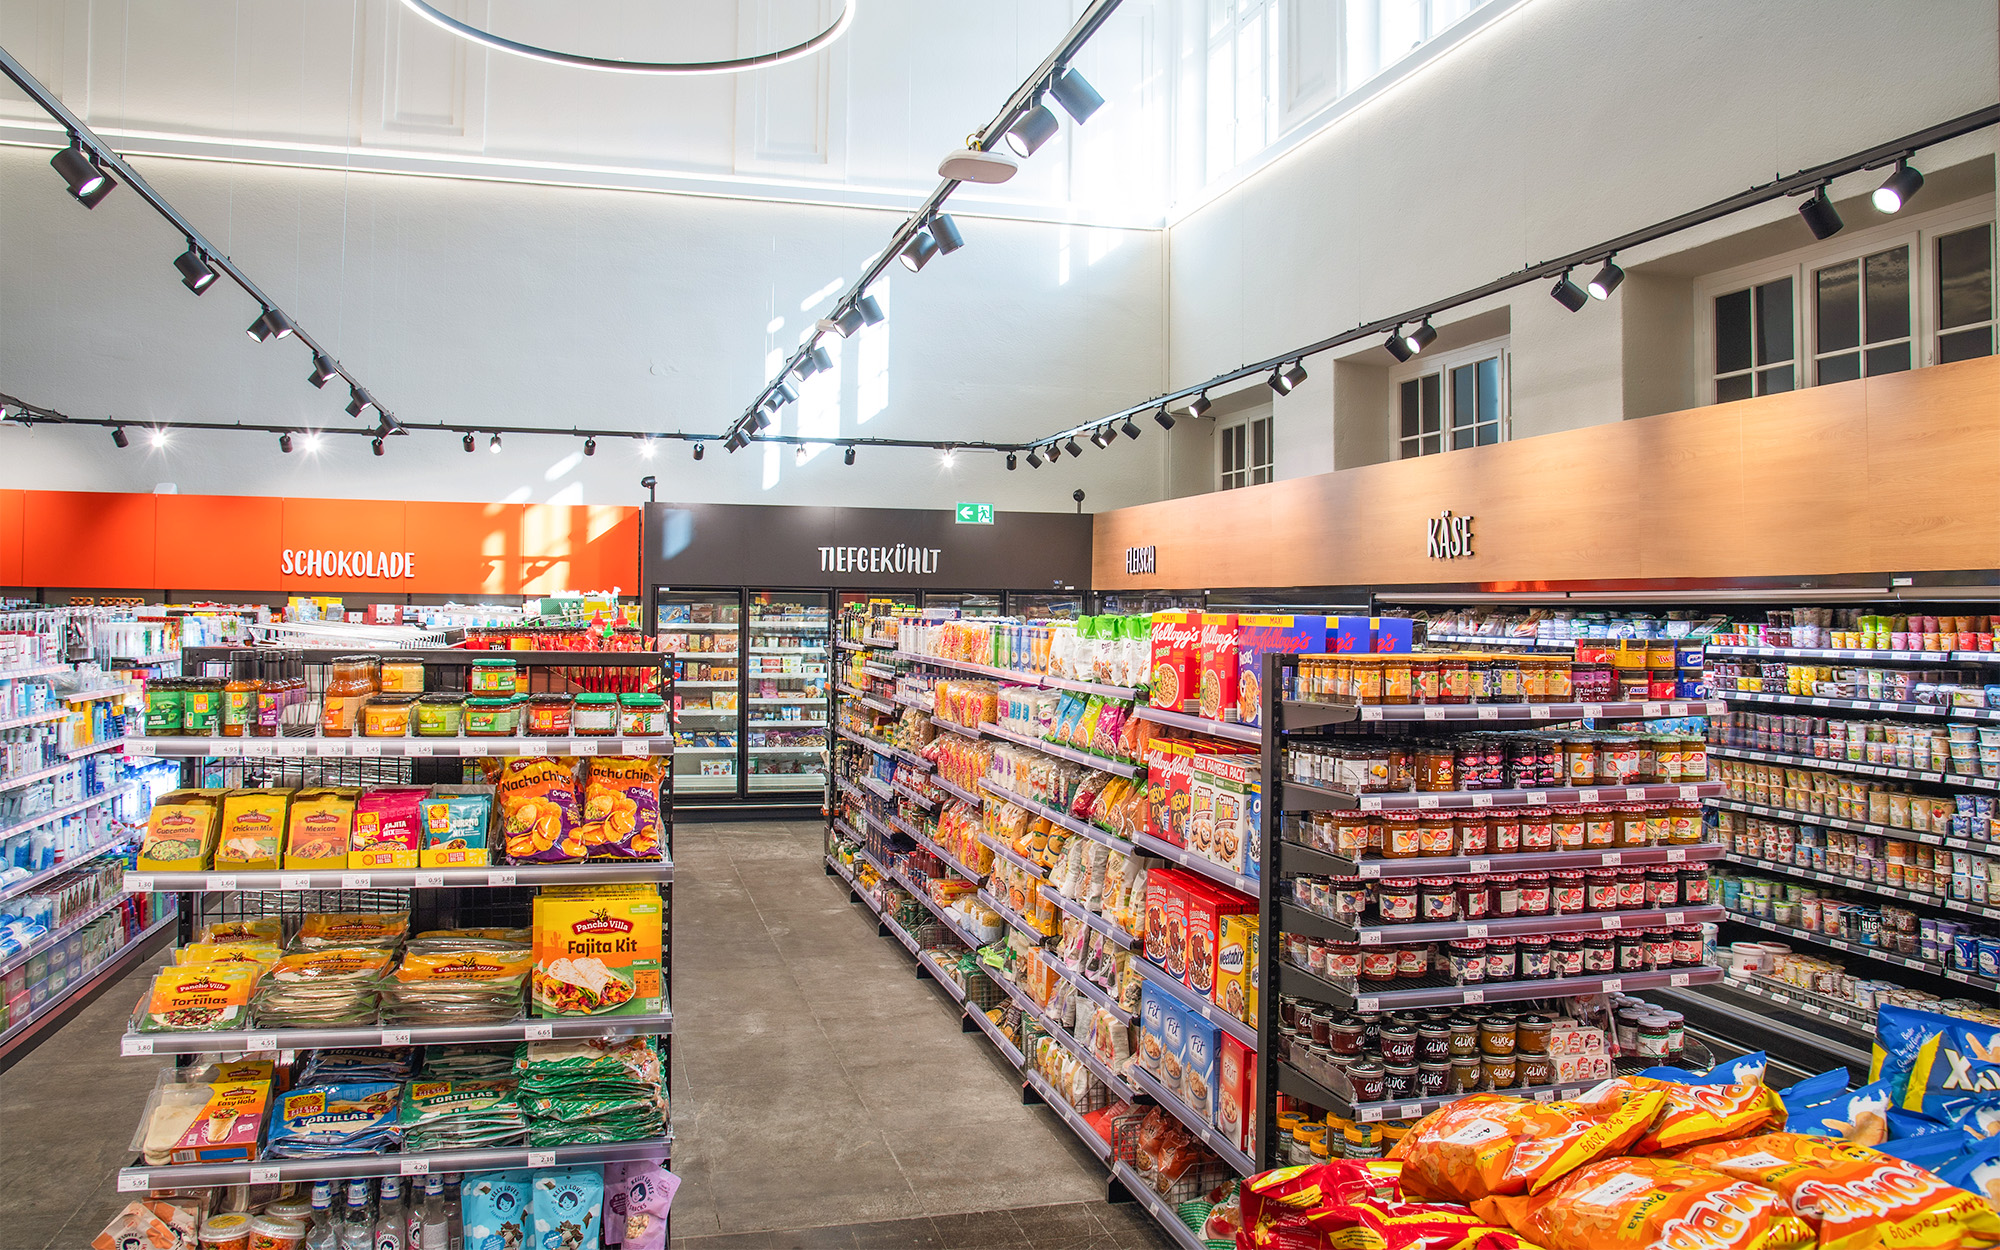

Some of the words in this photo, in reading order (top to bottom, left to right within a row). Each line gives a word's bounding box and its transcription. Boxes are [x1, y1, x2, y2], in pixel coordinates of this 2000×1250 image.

[1427, 511, 1474, 557] KÄSE
[281, 548, 416, 580] SCHOKOLADE
[818, 543, 941, 575] TIEFGEKÜHLT
[1126, 545, 1156, 575] FLEISCH
[1152, 622, 1200, 649] Kellogg's
[624, 769, 655, 782] Chips
[1229, 766, 1245, 782] PACK
[501, 775, 541, 793] Nacho
[541, 770, 572, 786] Chips
[156, 827, 196, 835] Guacamole
[232, 824, 260, 832] Chicken
[383, 820, 407, 831] FAJITA
[383, 829, 396, 837] MIX
[452, 829, 465, 838] MIX
[575, 920, 609, 933] Pancho
[609, 920, 629, 932] Villa
[567, 939, 613, 957] Fajita
[615, 937, 639, 953] Kit
[1219, 950, 1245, 966] Weetabix
[180, 982, 209, 993] Pancho
[209, 982, 226, 990] Villa
[171, 997, 228, 1007] Tortillas
[1146, 1000, 1161, 1019] Fit
[537, 1029, 551, 1037] 6.65
[1166, 1017, 1181, 1038] Fit
[261, 1040, 275, 1048] 4.55
[396, 1035, 409, 1043] 5.45
[1190, 1033, 1206, 1056] Fit
[1455, 1034, 1475, 1047] GLÜCK
[137, 1044, 152, 1052] 3.80
[1426, 1040, 1449, 1053] GLÜCK
[330, 1049, 390, 1058] TORTILLAS
[1526, 1064, 1548, 1078] GLÜCK
[1418, 1073, 1443, 1087] GLÜCK
[217, 1099, 237, 1107] Easy
[238, 1097, 256, 1106] Hold
[429, 1091, 494, 1105] TORTILLAS
[301, 1112, 368, 1127] TORTILLAS
[1580, 1132, 1605, 1154] 200g
[264, 1172, 278, 1180] 3.80
[630, 1175, 645, 1185] KELLY
[132, 1179, 147, 1187] 5.95
[490, 1186, 503, 1201] KELLY
[504, 1185, 520, 1197] LOVES
[552, 1184, 568, 1198] KELLY
[568, 1184, 585, 1197] LOVES
[1628, 1193, 1667, 1230] Paprika
